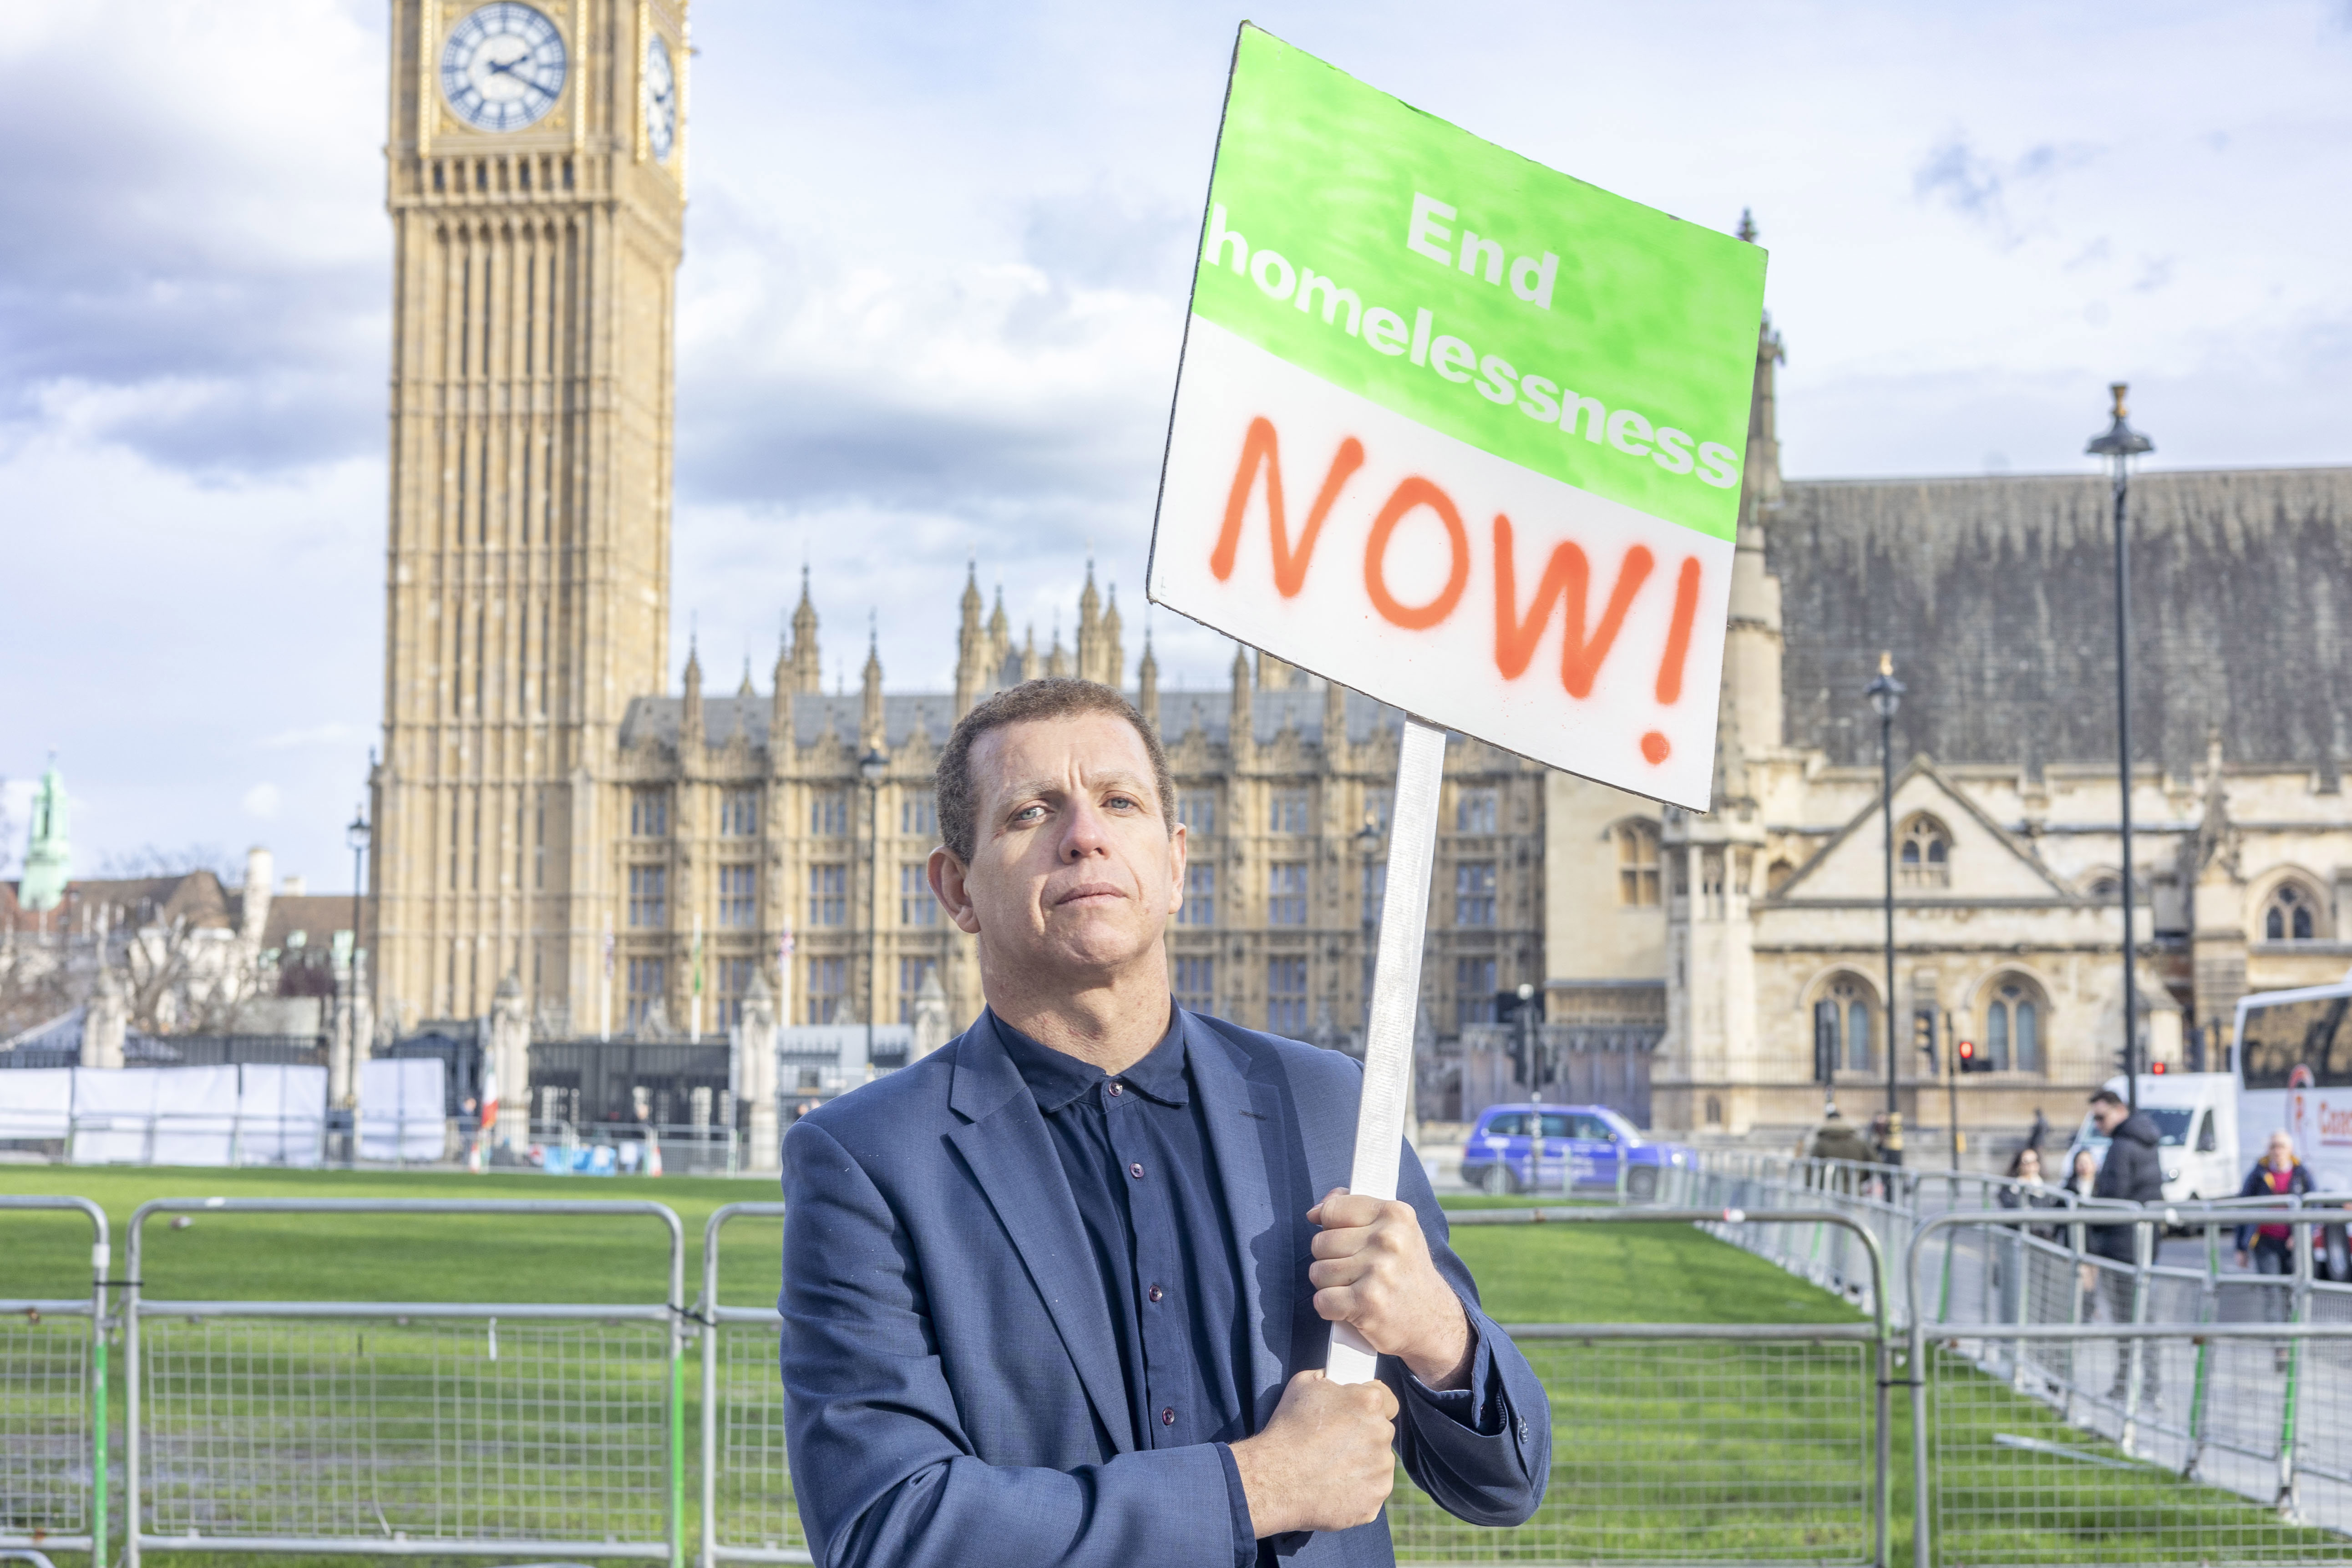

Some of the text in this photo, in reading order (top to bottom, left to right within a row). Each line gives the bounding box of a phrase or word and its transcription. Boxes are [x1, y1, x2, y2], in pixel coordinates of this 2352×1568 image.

[1205, 202, 1738, 488] homelessness
[1408, 192, 1558, 310] End
[1209, 415, 1703, 766] NOW!
